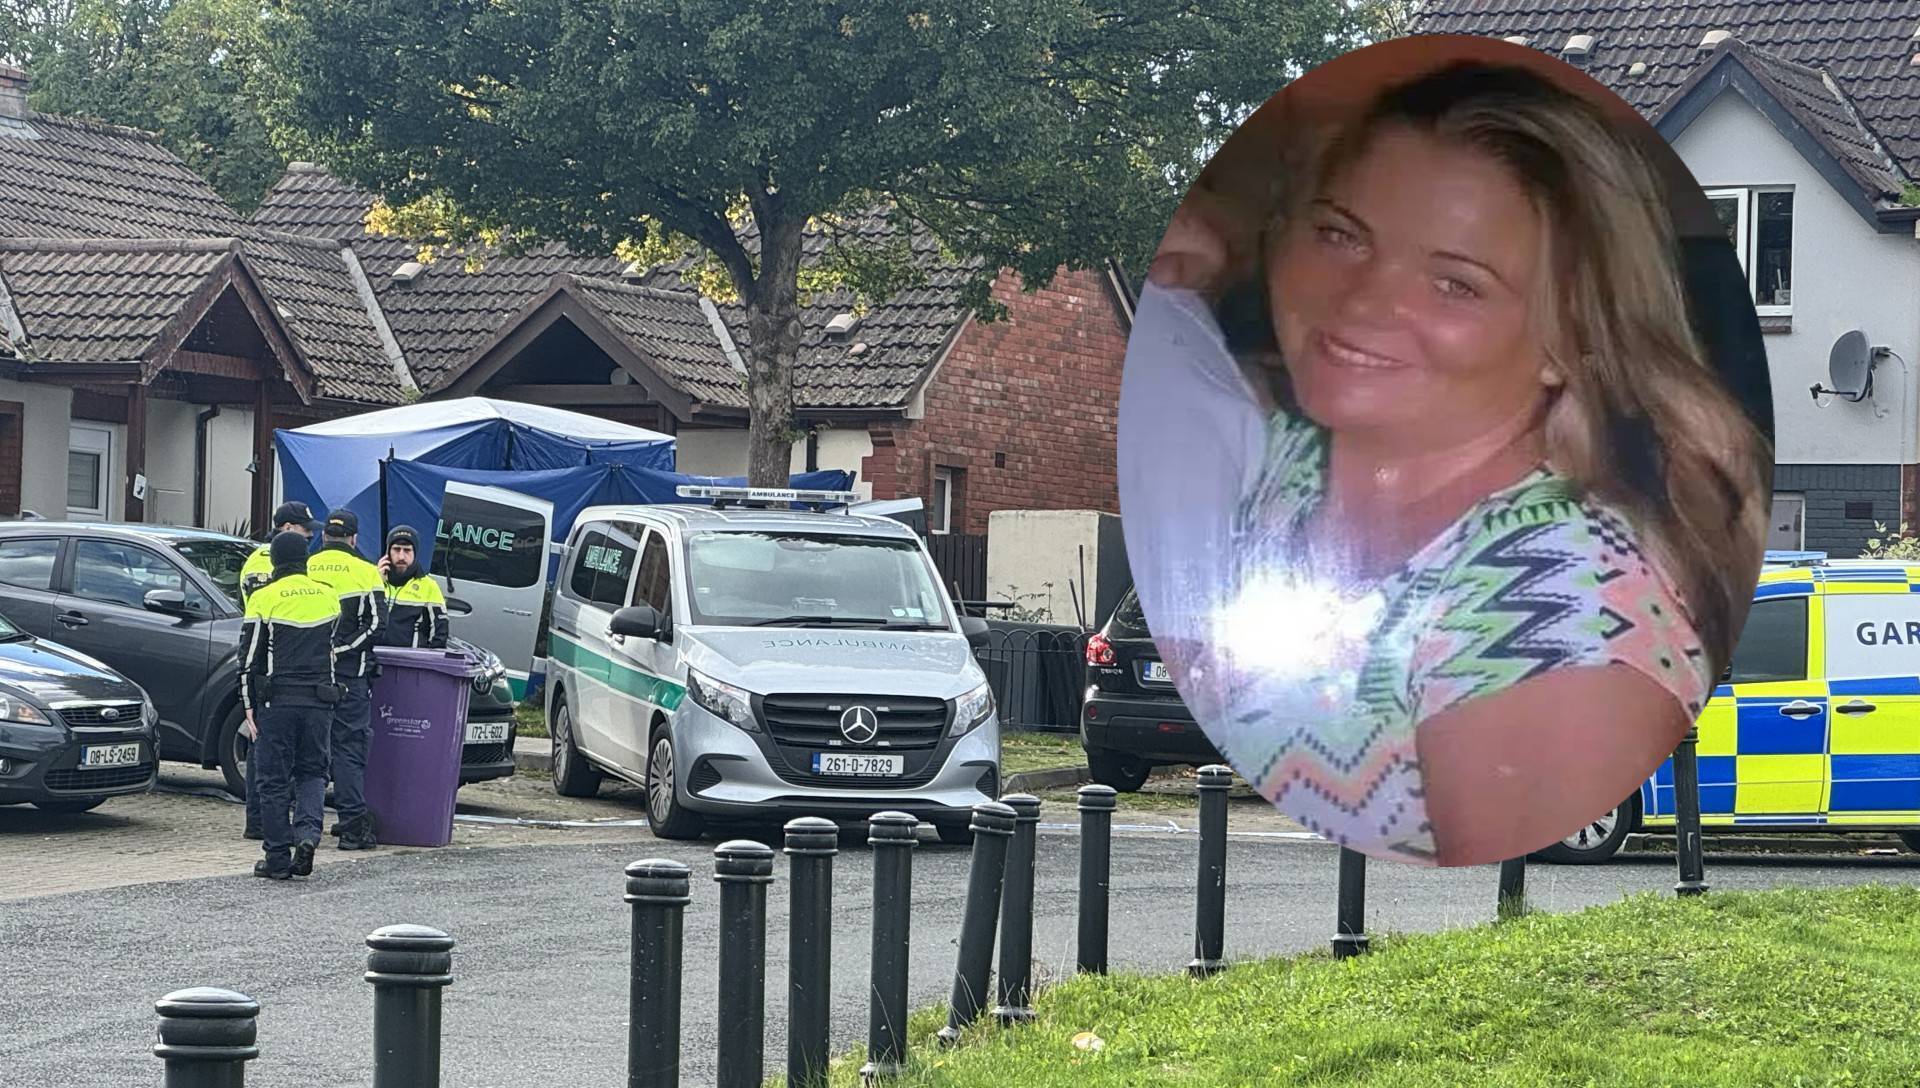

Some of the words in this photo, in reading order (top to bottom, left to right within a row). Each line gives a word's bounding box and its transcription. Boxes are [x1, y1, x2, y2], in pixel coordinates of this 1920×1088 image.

[436, 519, 515, 551] LANCE
[309, 564, 350, 573] GARDA
[280, 588, 324, 598] GARDA
[1856, 621, 1920, 646] GAR
[90, 747, 136, 764] 08-LS-2459
[826, 758, 893, 773] 261-D-7829
